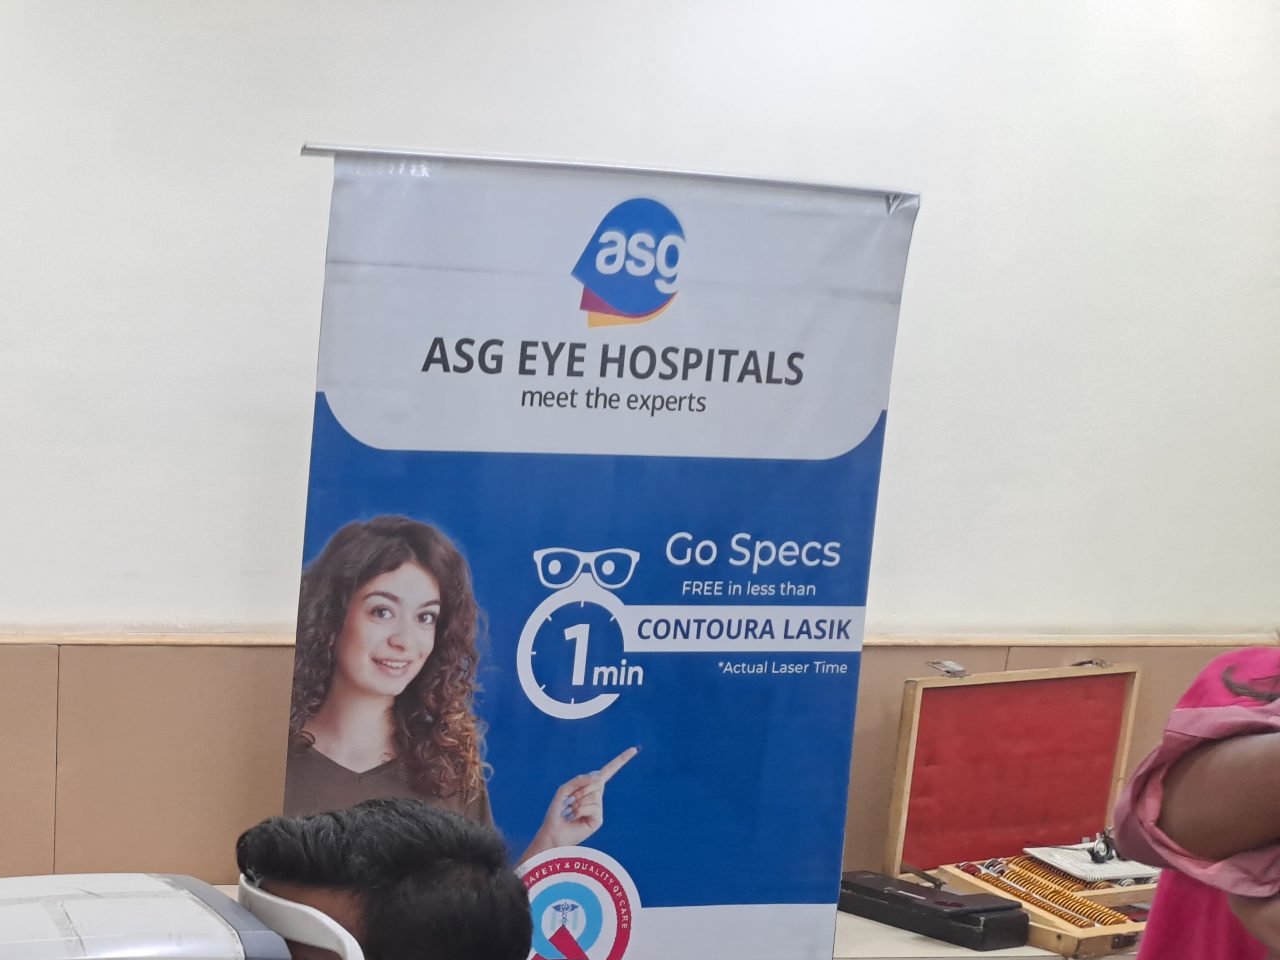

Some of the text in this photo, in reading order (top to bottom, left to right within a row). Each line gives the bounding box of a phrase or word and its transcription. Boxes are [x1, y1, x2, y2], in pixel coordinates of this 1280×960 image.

[596, 230, 686, 293] asg
[422, 337, 805, 386] ASG EYE HOSPITALS
[521, 386, 706, 416] meet the experts
[665, 532, 841, 573] Go Specs
[682, 581, 816, 597] FREE in less than
[637, 618, 853, 640] CONTOURA LASIK
[563, 623, 644, 686] 1 min
[772, 661, 809, 675] Laser
[813, 662, 848, 674] Time
[574, 862, 615, 885] QUALITY
[613, 886, 623, 899] OF
[619, 900, 629, 929] CARE
